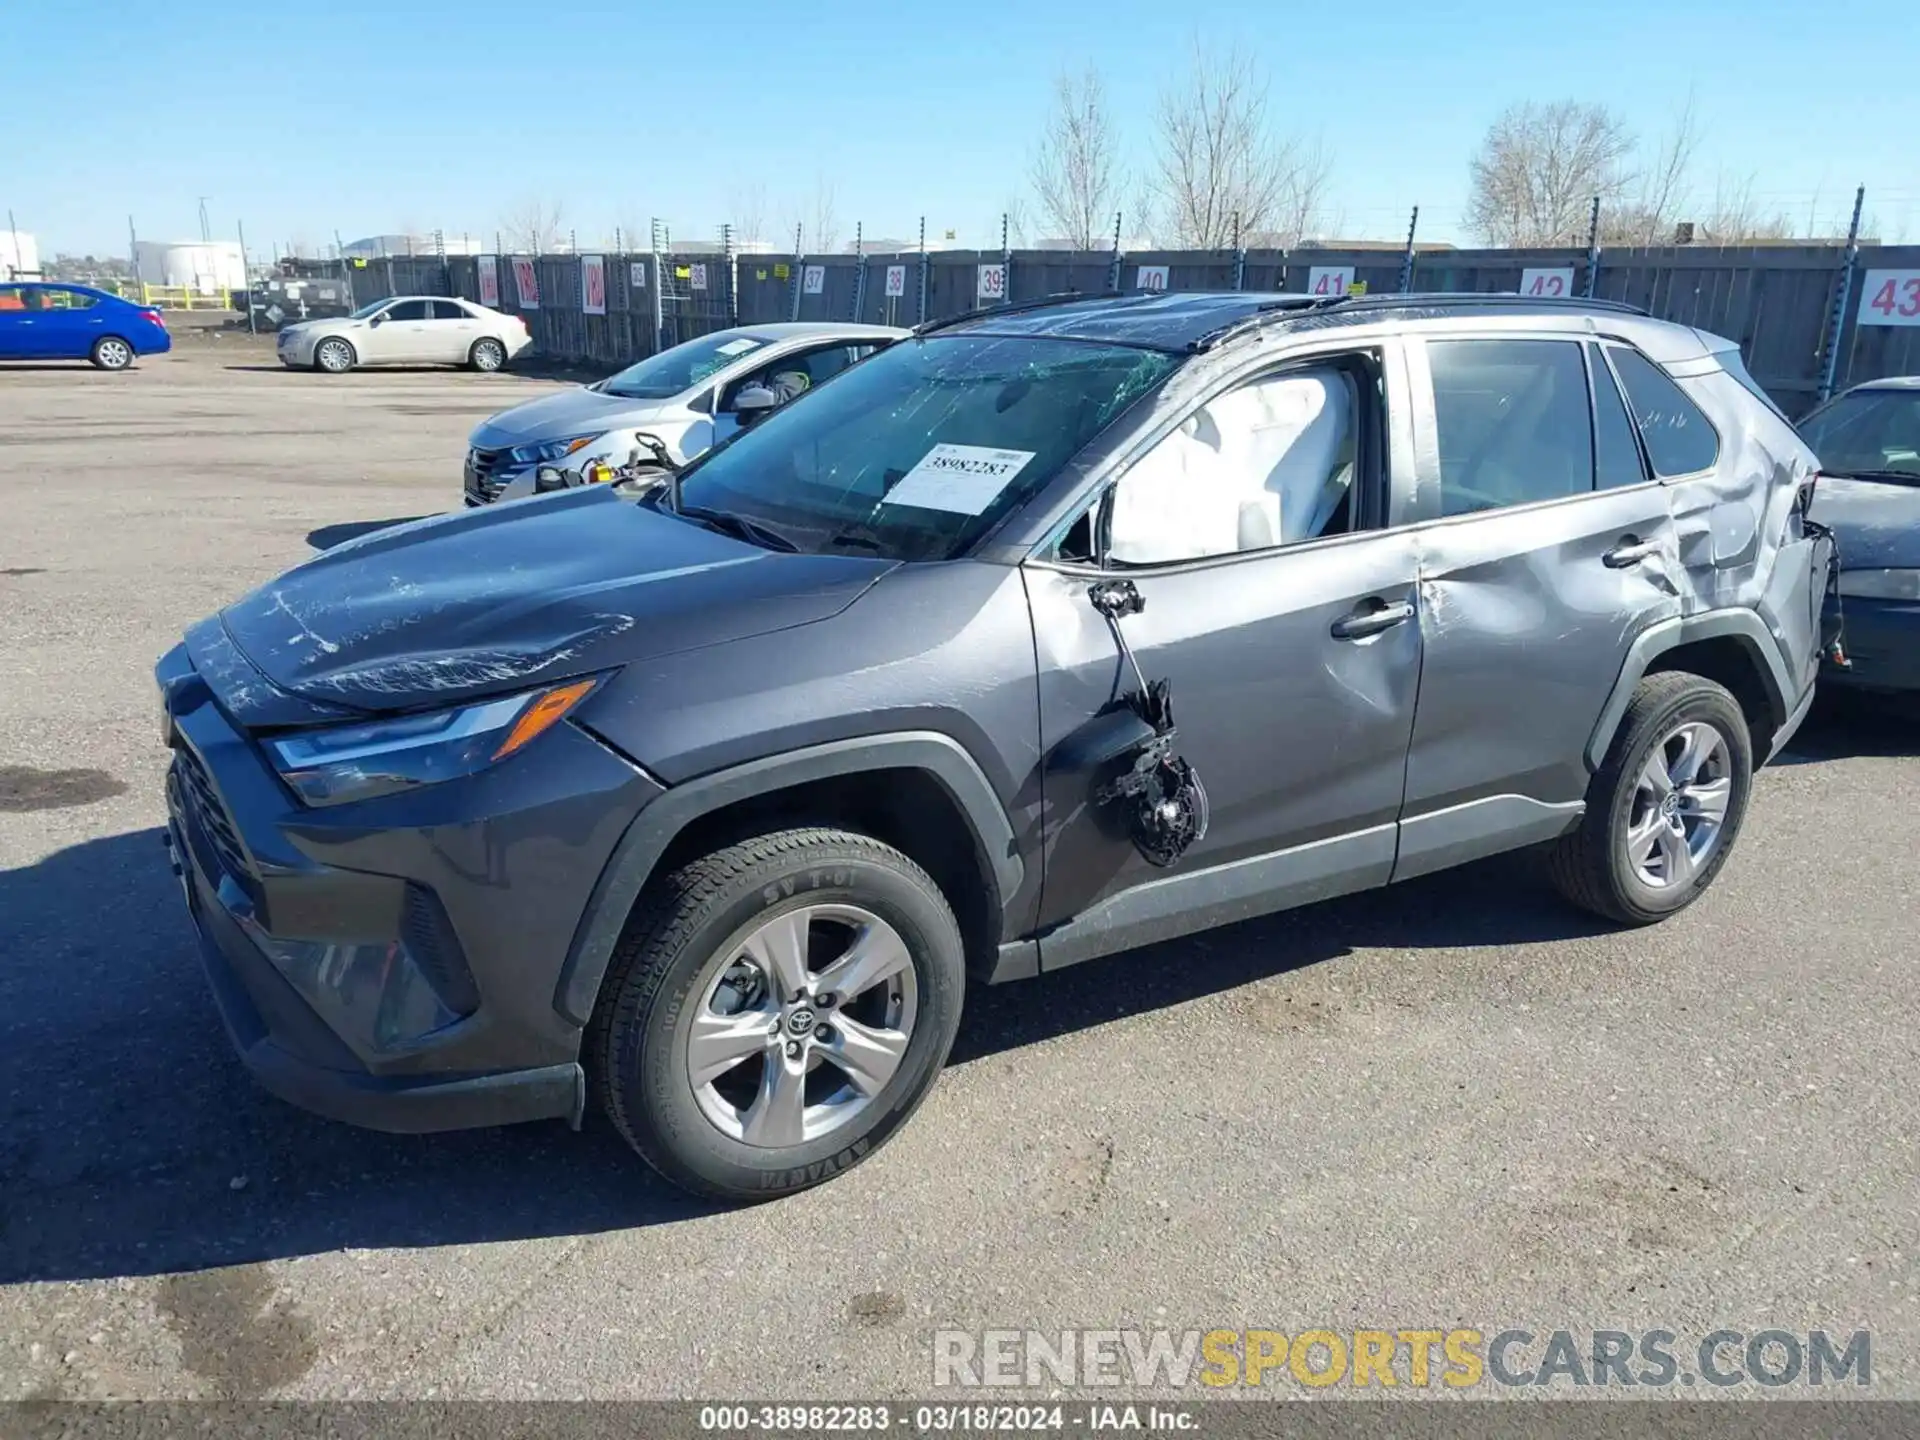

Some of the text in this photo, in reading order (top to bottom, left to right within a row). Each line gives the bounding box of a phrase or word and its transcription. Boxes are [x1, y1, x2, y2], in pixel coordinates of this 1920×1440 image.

[806, 270, 821, 288] 37
[887, 271, 902, 291] 38
[984, 270, 1001, 293] 39
[1314, 273, 1344, 295] 41
[1528, 275, 1563, 297] 42
[1871, 278, 1920, 317] 43
[924, 456, 1008, 476] 38982283
